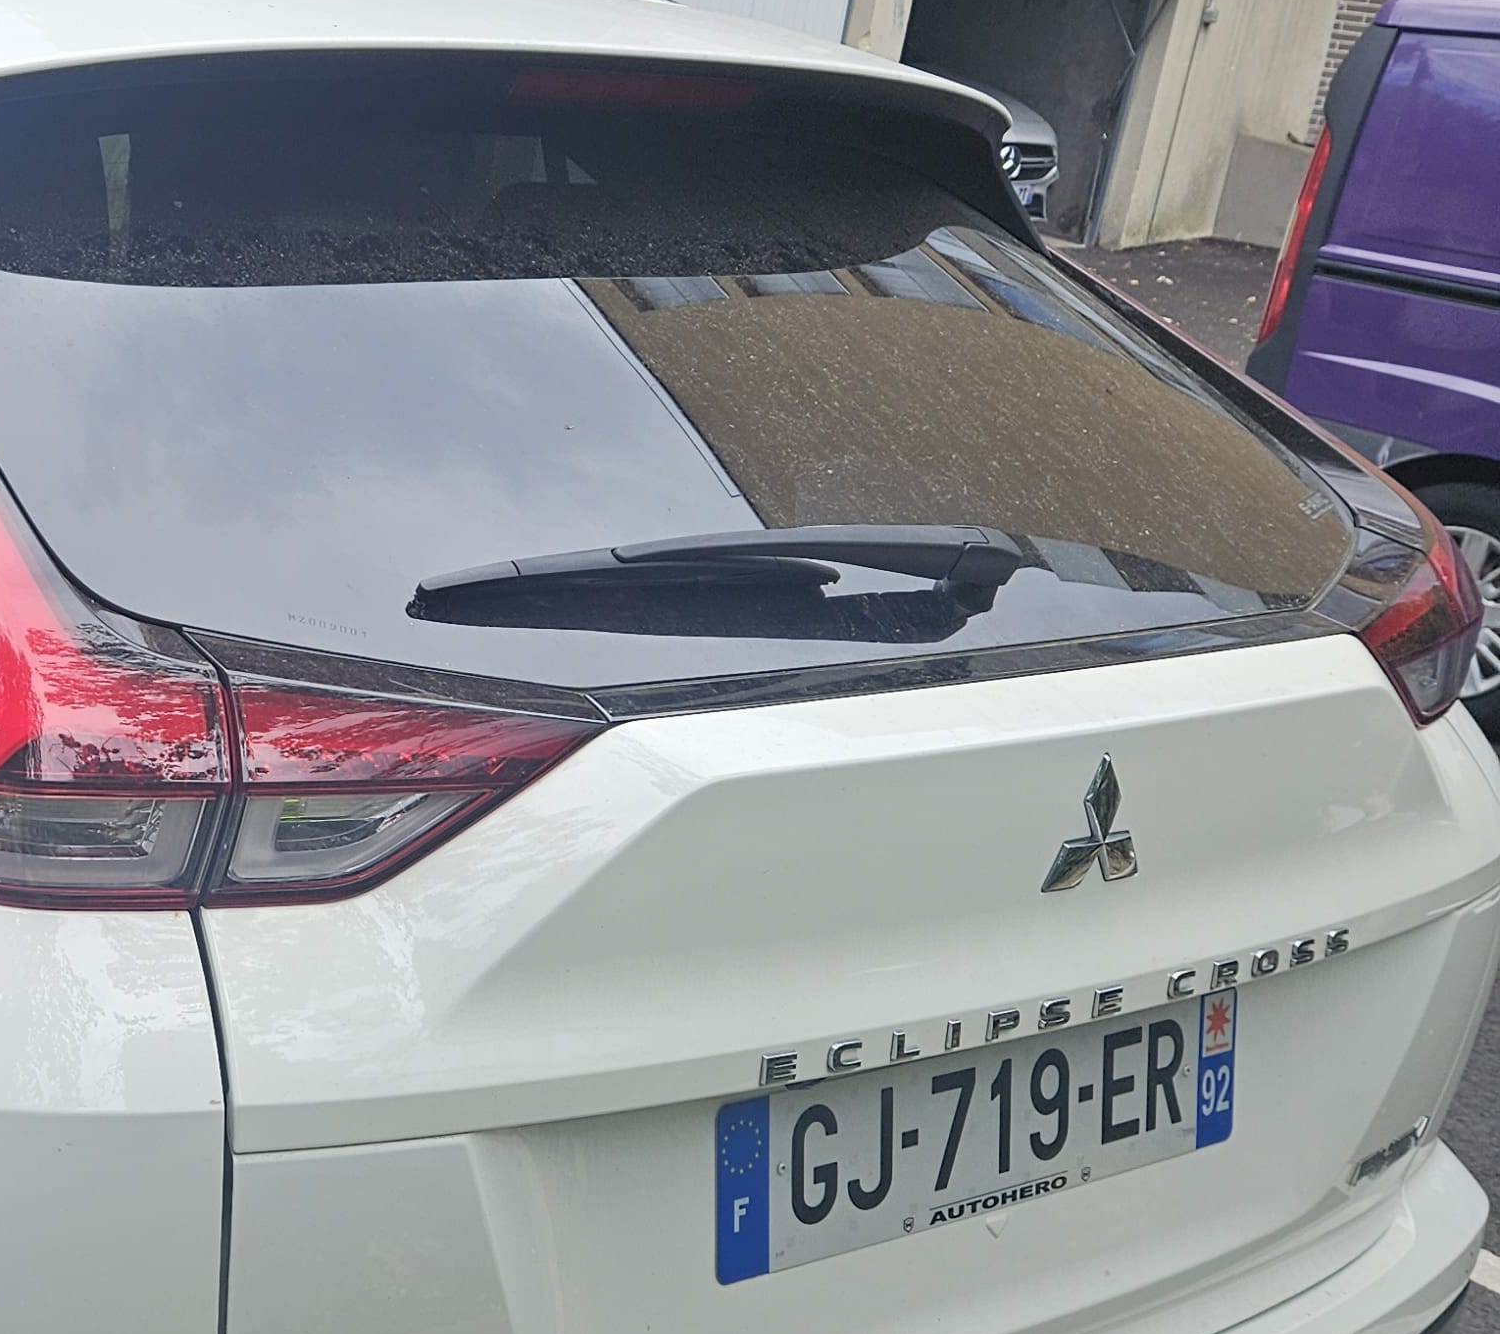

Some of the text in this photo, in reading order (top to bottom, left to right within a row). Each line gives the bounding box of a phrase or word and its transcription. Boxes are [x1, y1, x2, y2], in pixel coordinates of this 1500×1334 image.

[759, 927, 1350, 1086] ECLIPSE CROSS
[1202, 1065, 1230, 1116] 92
[791, 1019, 1184, 1225] GJ-719-ER
[733, 1197, 749, 1233] F
[929, 1176, 1068, 1226] AUTOHERO
